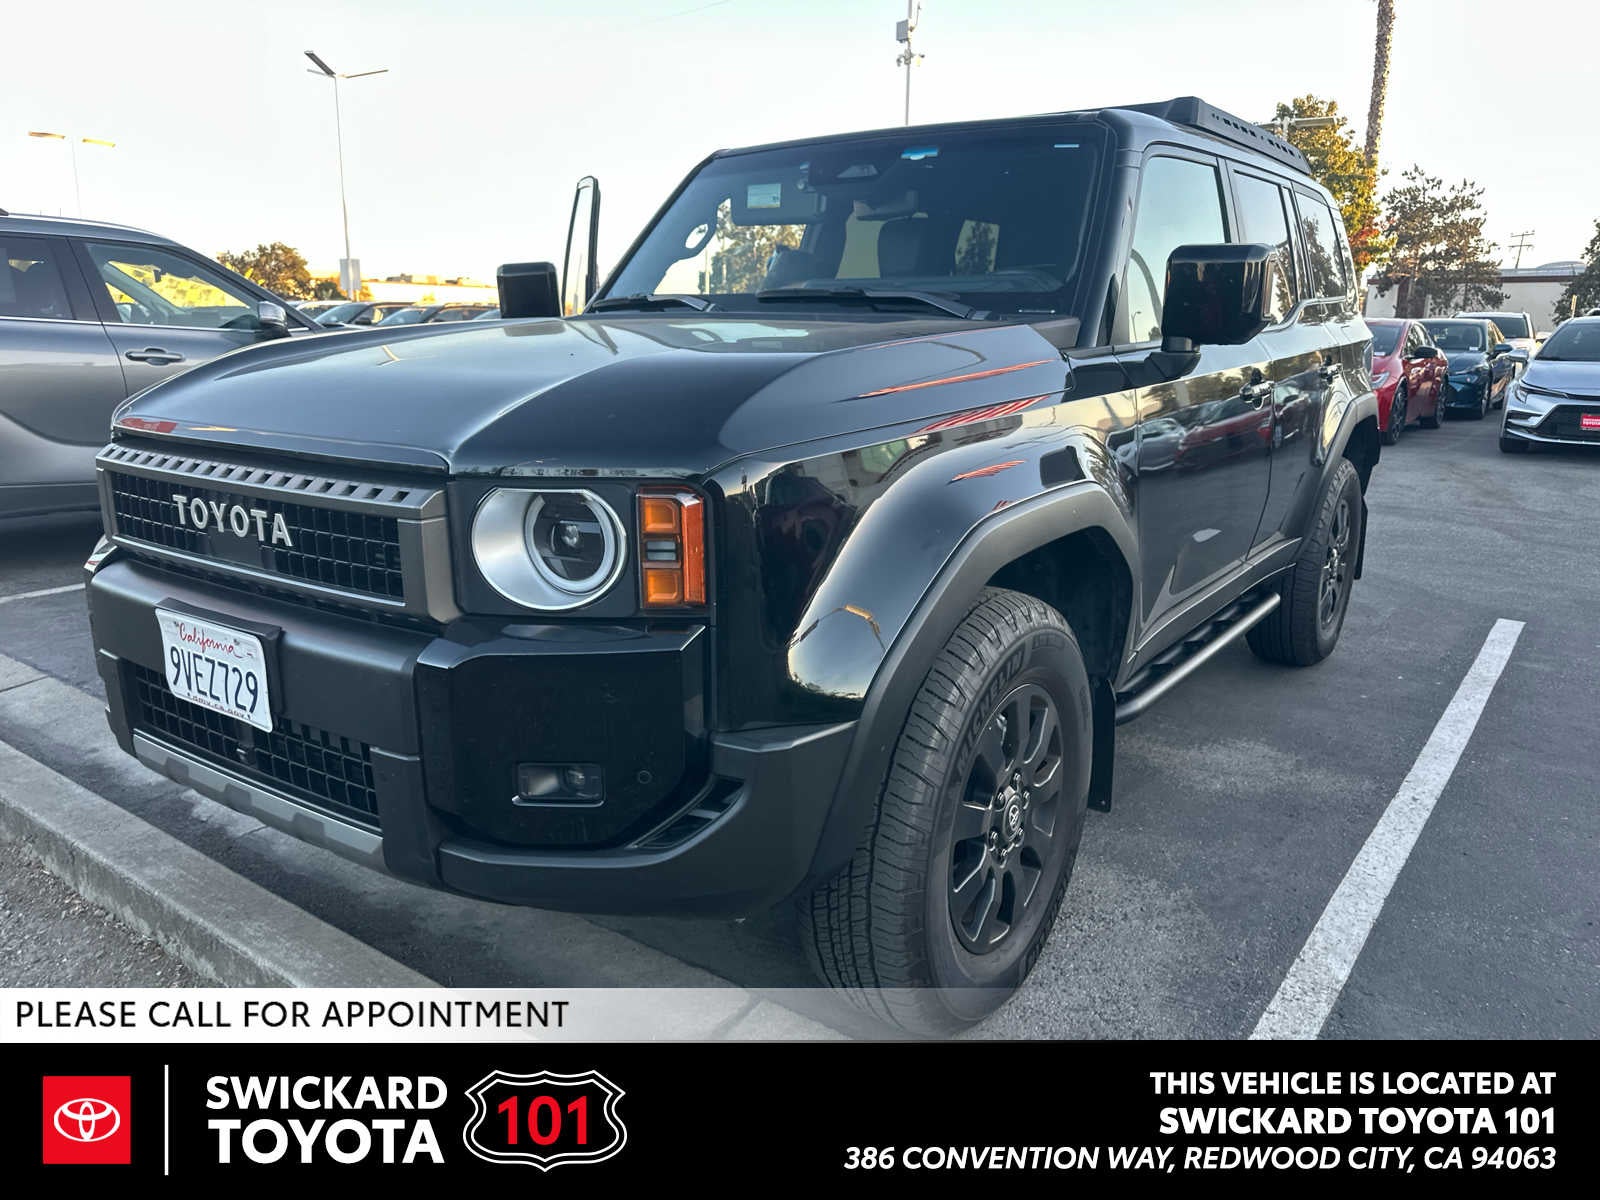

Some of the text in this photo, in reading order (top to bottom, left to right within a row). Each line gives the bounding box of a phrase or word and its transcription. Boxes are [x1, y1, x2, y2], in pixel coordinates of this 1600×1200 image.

[172, 494, 293, 547] TOYOTA
[178, 622, 242, 659] California
[170, 646, 259, 714] 9VEZ729
